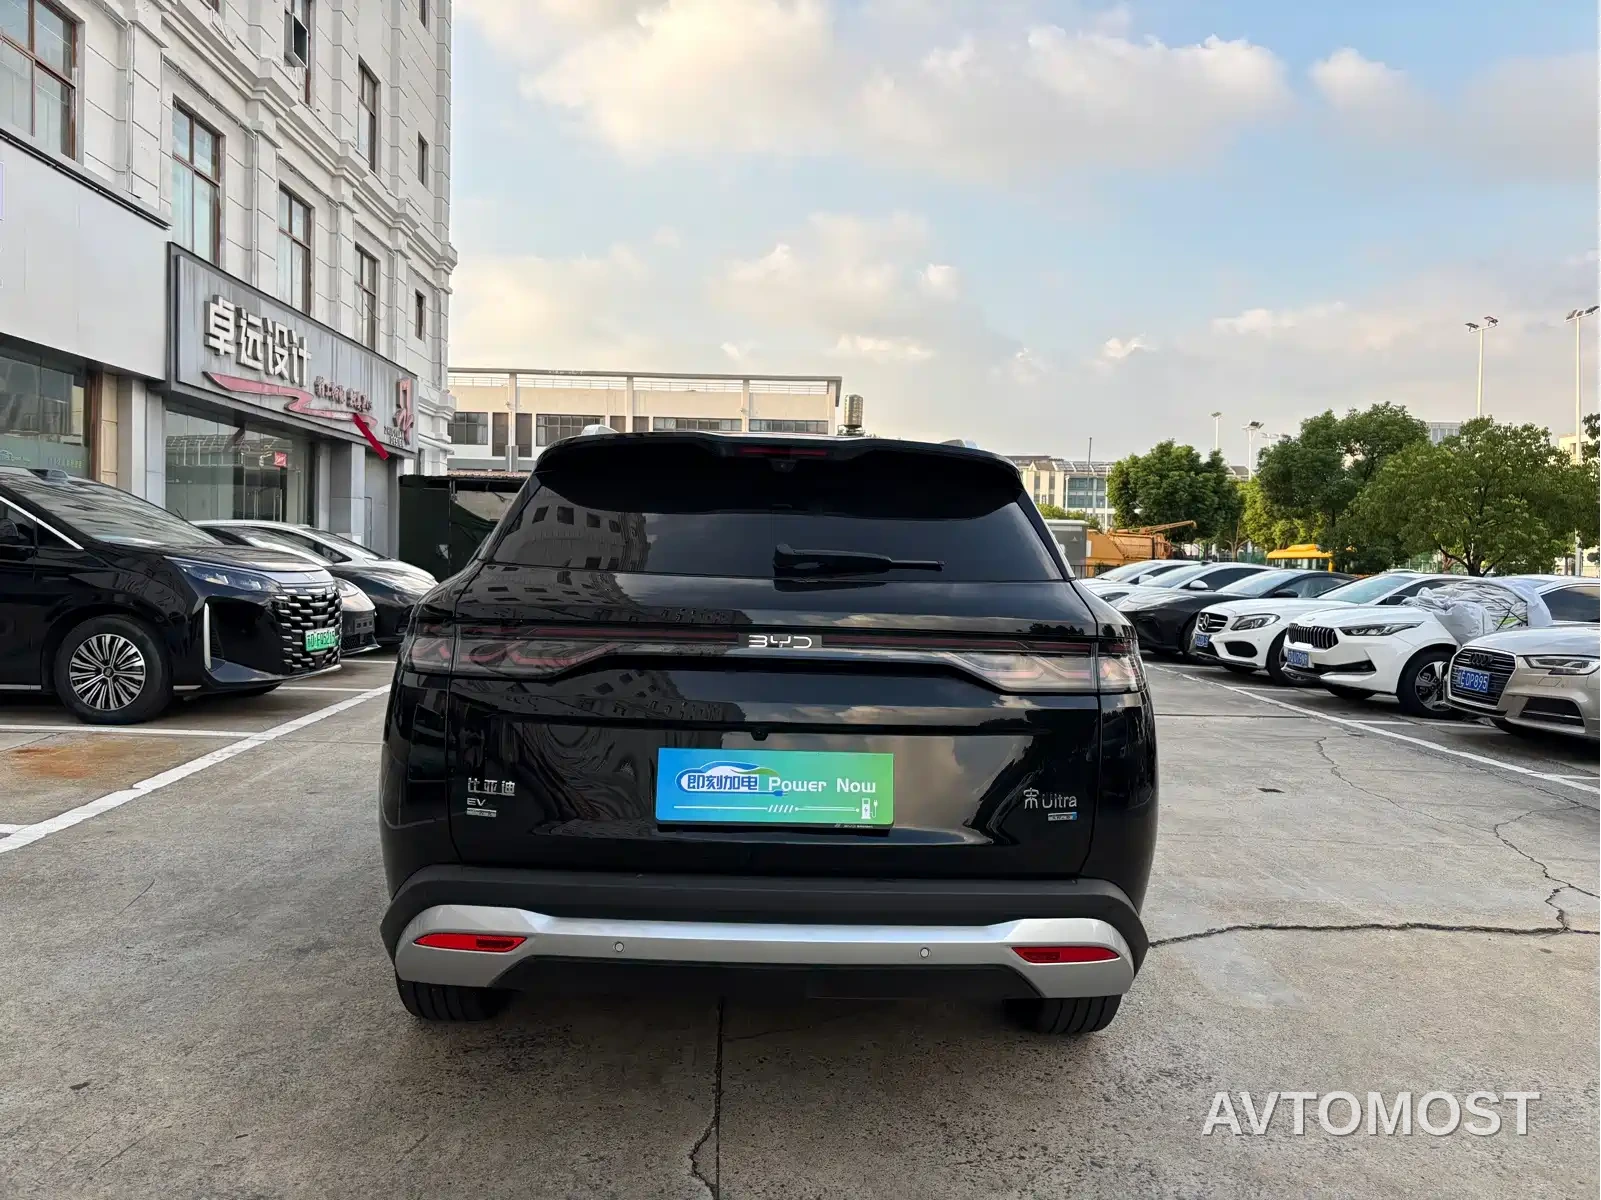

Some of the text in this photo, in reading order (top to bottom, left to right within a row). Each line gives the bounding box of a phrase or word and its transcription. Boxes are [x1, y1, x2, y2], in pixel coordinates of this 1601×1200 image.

[205, 295, 312, 387] 卓远设计
[749, 634, 812, 648] BYD
[467, 777, 516, 796] 比亚迪
[687, 774, 758, 791] 即刻加电
[768, 776, 876, 793] Power Now
[466, 797, 486, 807] EV
